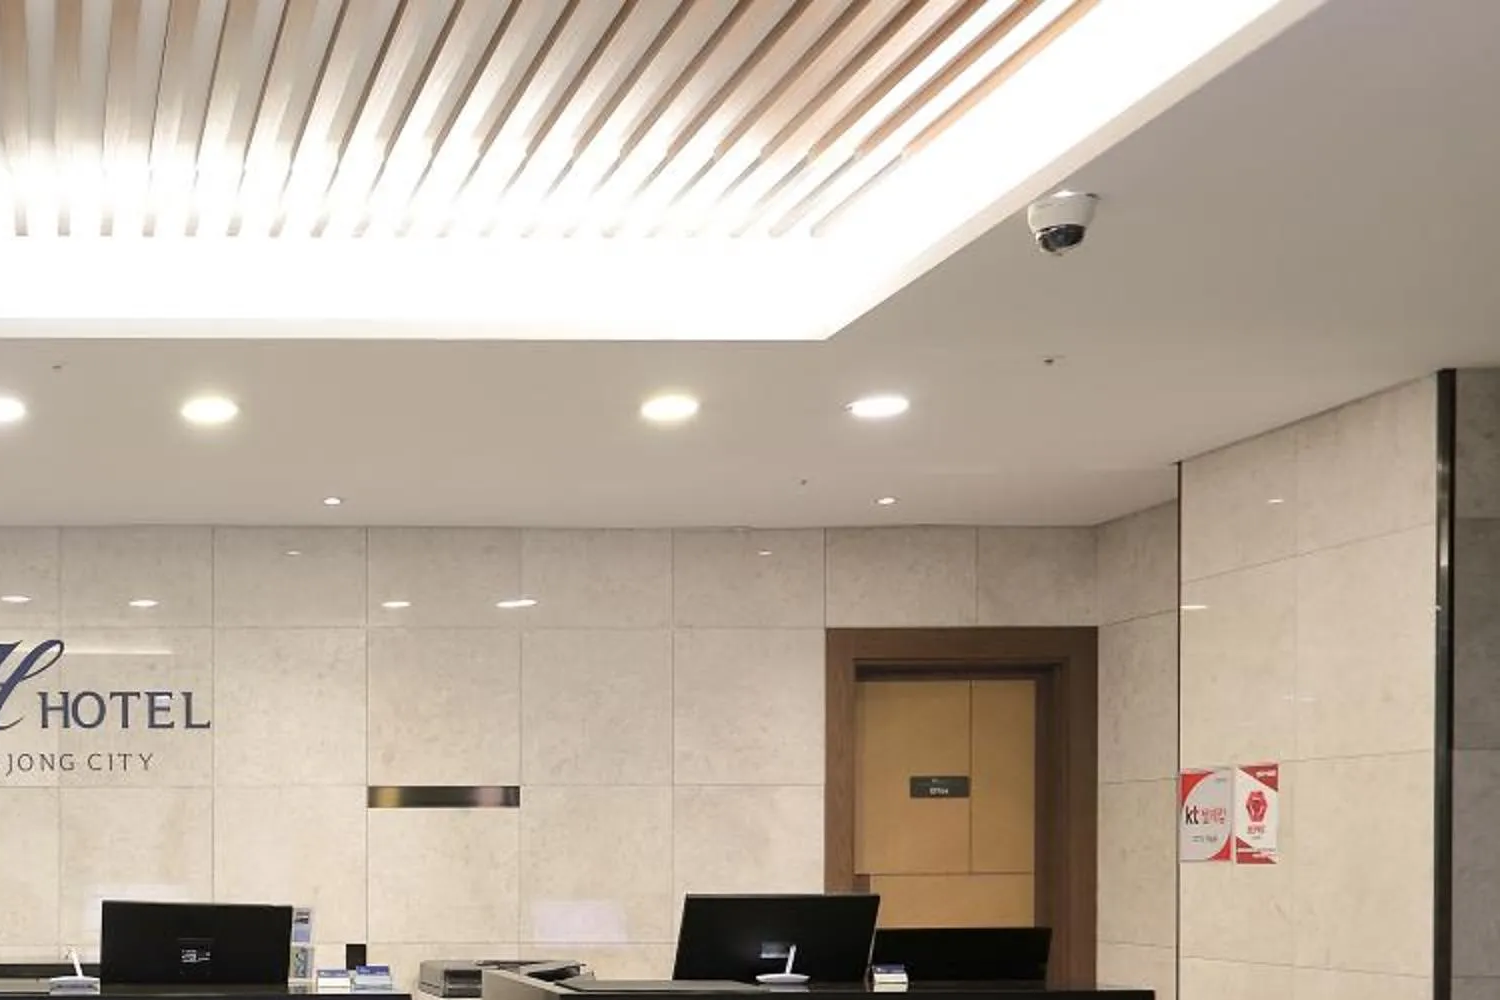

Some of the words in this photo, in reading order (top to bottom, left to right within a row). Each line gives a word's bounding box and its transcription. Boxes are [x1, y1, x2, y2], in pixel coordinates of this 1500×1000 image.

[37, 690, 212, 730] HOTEL
[86, 752, 155, 773] CITY
[1185, 804, 1200, 825] kt
